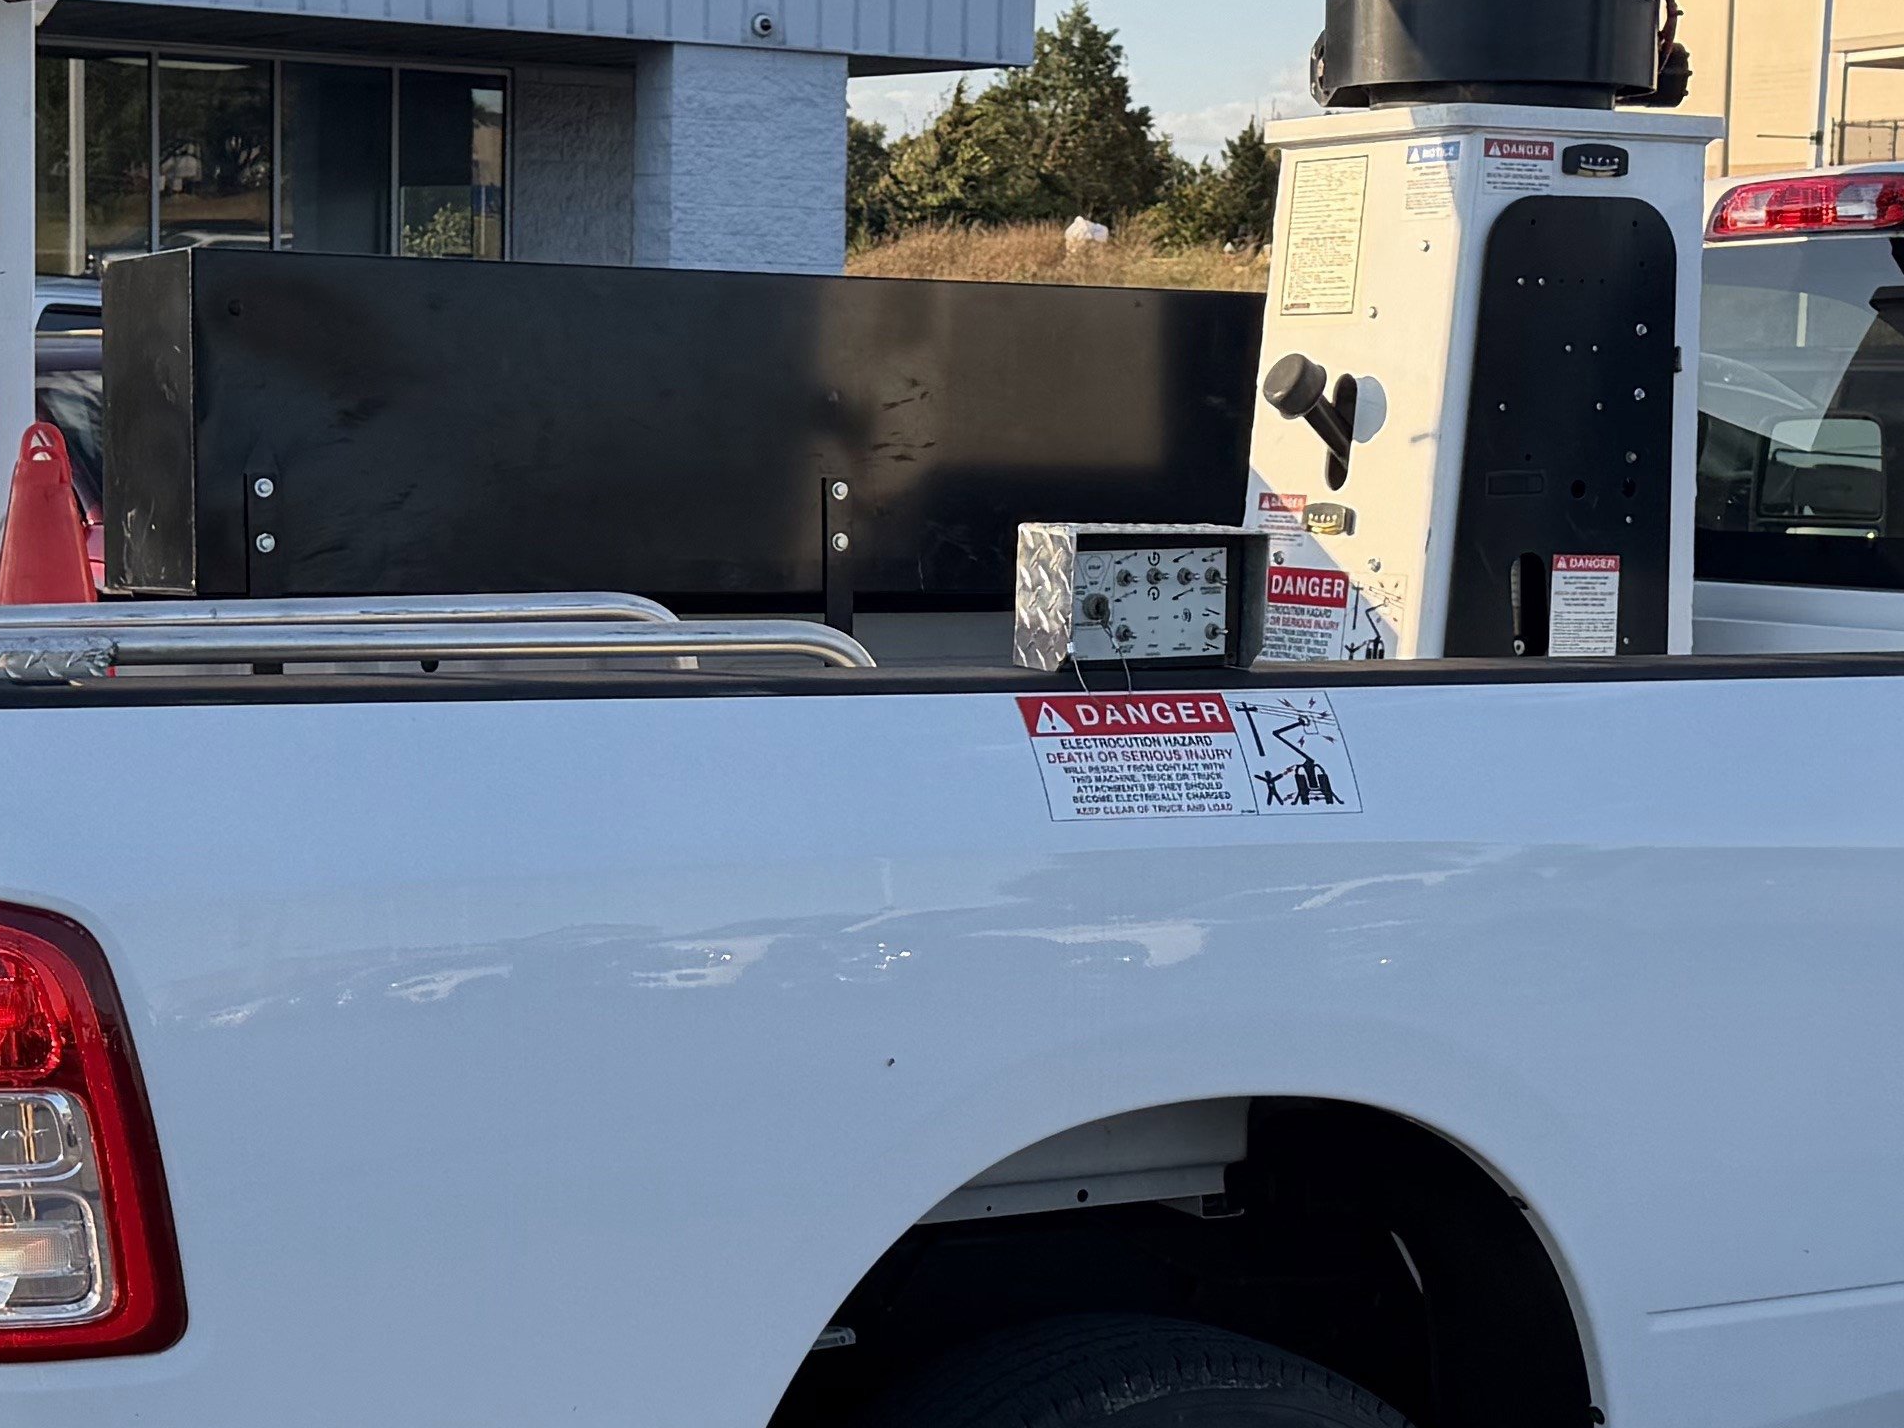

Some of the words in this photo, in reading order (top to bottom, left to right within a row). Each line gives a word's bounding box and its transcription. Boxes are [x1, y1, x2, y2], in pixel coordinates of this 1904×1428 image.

[1502, 142, 1550, 156] DANGER
[1569, 557, 1617, 569] DANGER
[1270, 575, 1345, 599] DANGER
[1074, 701, 1225, 726] DANGER
[1060, 736, 1162, 750] ELECTROCUTION
[1163, 735, 1213, 748] HAZARD
[1045, 751, 1094, 765] DEATH
[1097, 751, 1119, 763] OR
[1122, 750, 1182, 762] SERIOUS
[1185, 748, 1234, 761] INJURY
[1156, 762, 1200, 772] CONTACT
[1156, 783, 1183, 792] THEY
